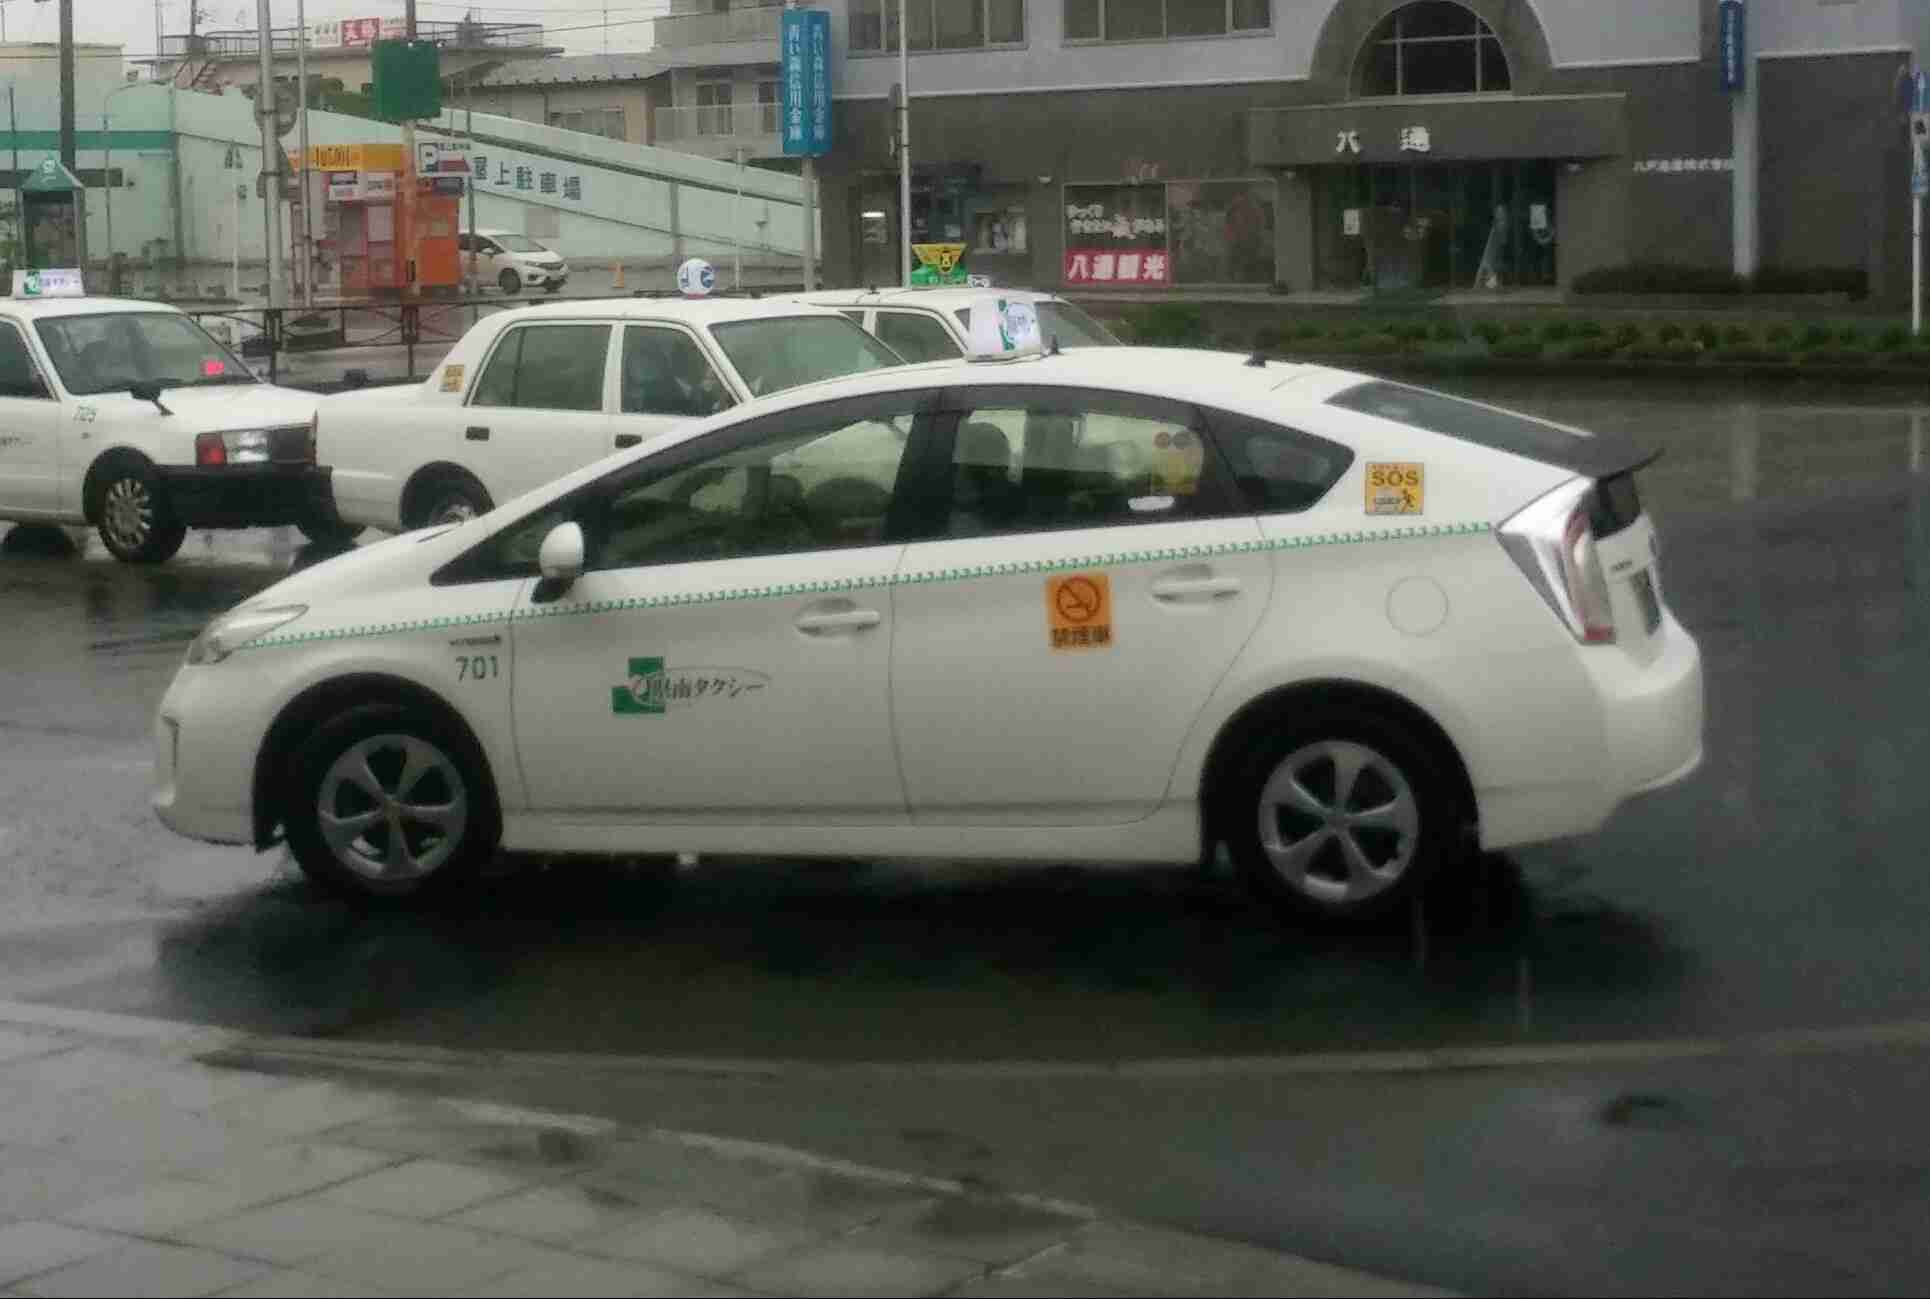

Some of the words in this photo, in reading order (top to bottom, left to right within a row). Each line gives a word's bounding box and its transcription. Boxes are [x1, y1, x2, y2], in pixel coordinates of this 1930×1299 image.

[472, 156, 582, 201] 屋上駐車場
[1371, 469, 1419, 487] SOS
[455, 655, 498, 682] 701
